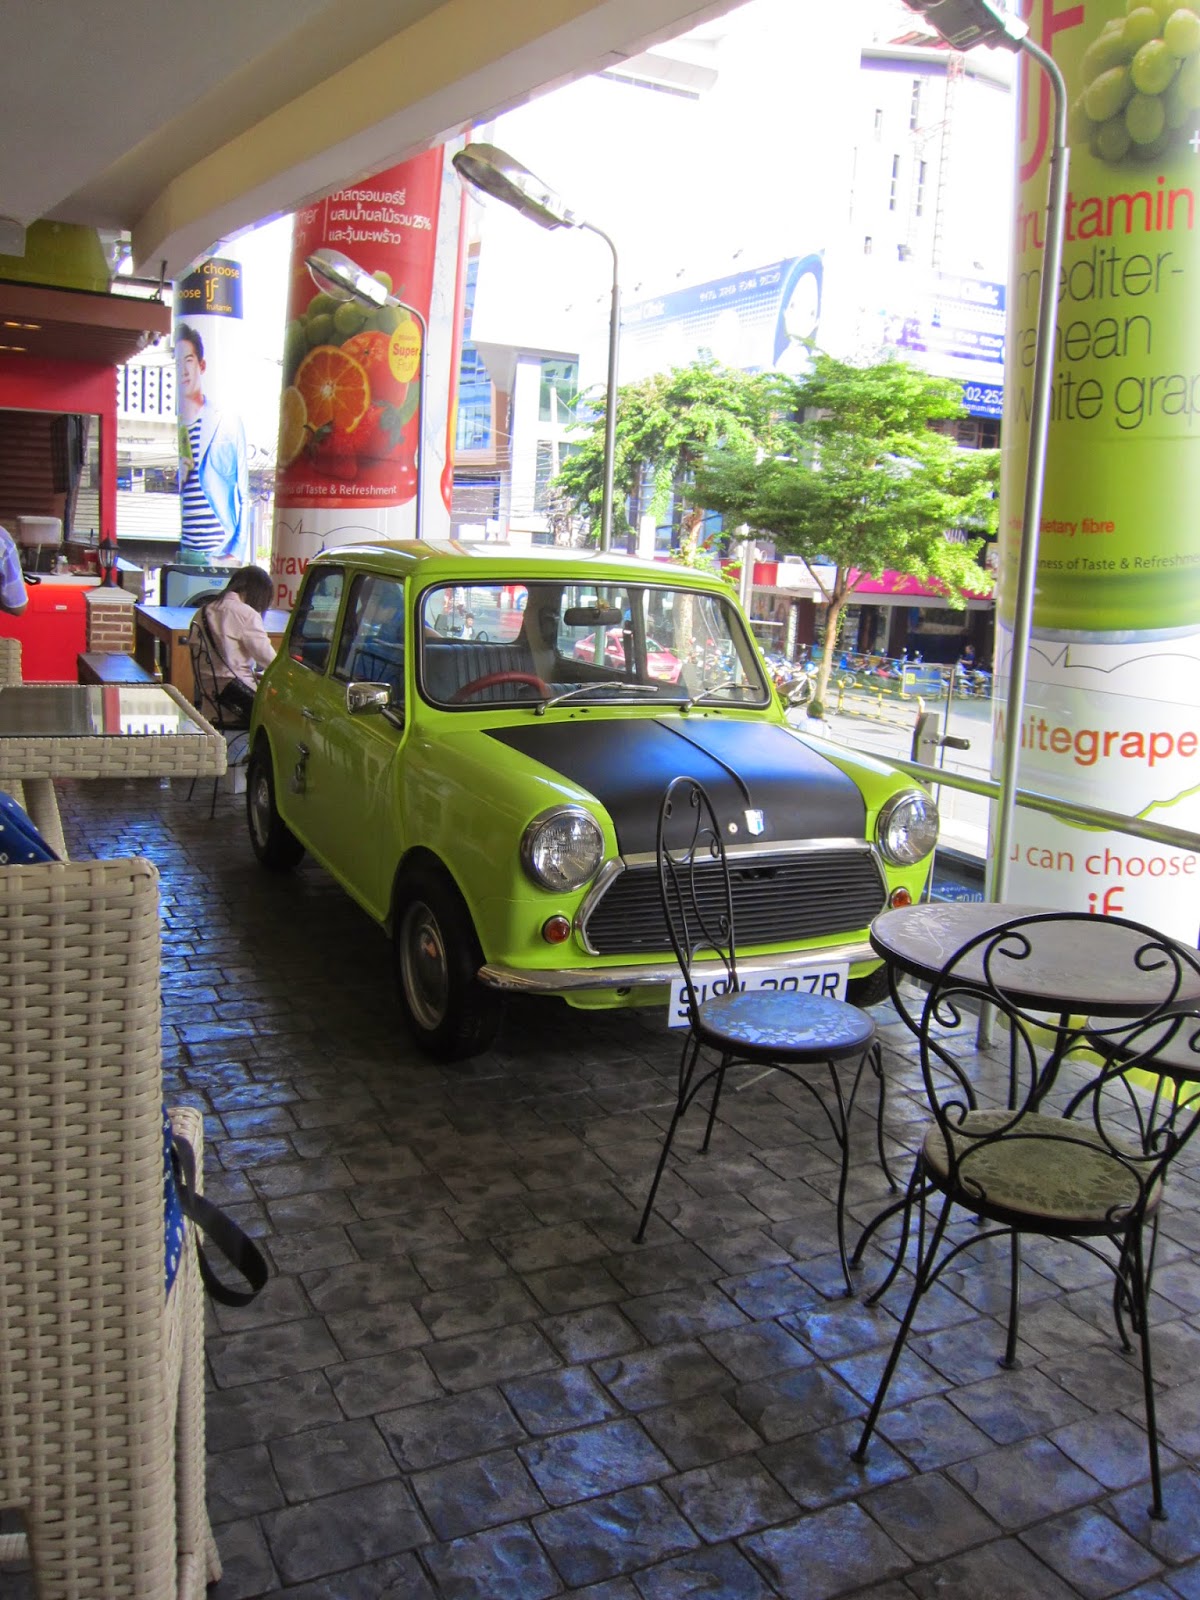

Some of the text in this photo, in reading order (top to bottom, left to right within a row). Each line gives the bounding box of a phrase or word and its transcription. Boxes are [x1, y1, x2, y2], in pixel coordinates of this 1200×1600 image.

[412, 214, 432, 230] 25%
[1017, 176, 1195, 253] frutamin
[203, 263, 240, 279] choose
[393, 342, 419, 359] Super
[305, 484, 328, 495] Taste
[329, 484, 337, 495] &
[339, 484, 397, 495] Refreshment
[1039, 518, 1078, 537] ietary
[1082, 518, 1116, 534] fibre
[1066, 558, 1080, 570] of
[1082, 558, 1116, 570] Taste
[1120, 559, 1130, 570] &
[1026, 845, 1074, 873] can
[1085, 848, 1197, 877] choose
